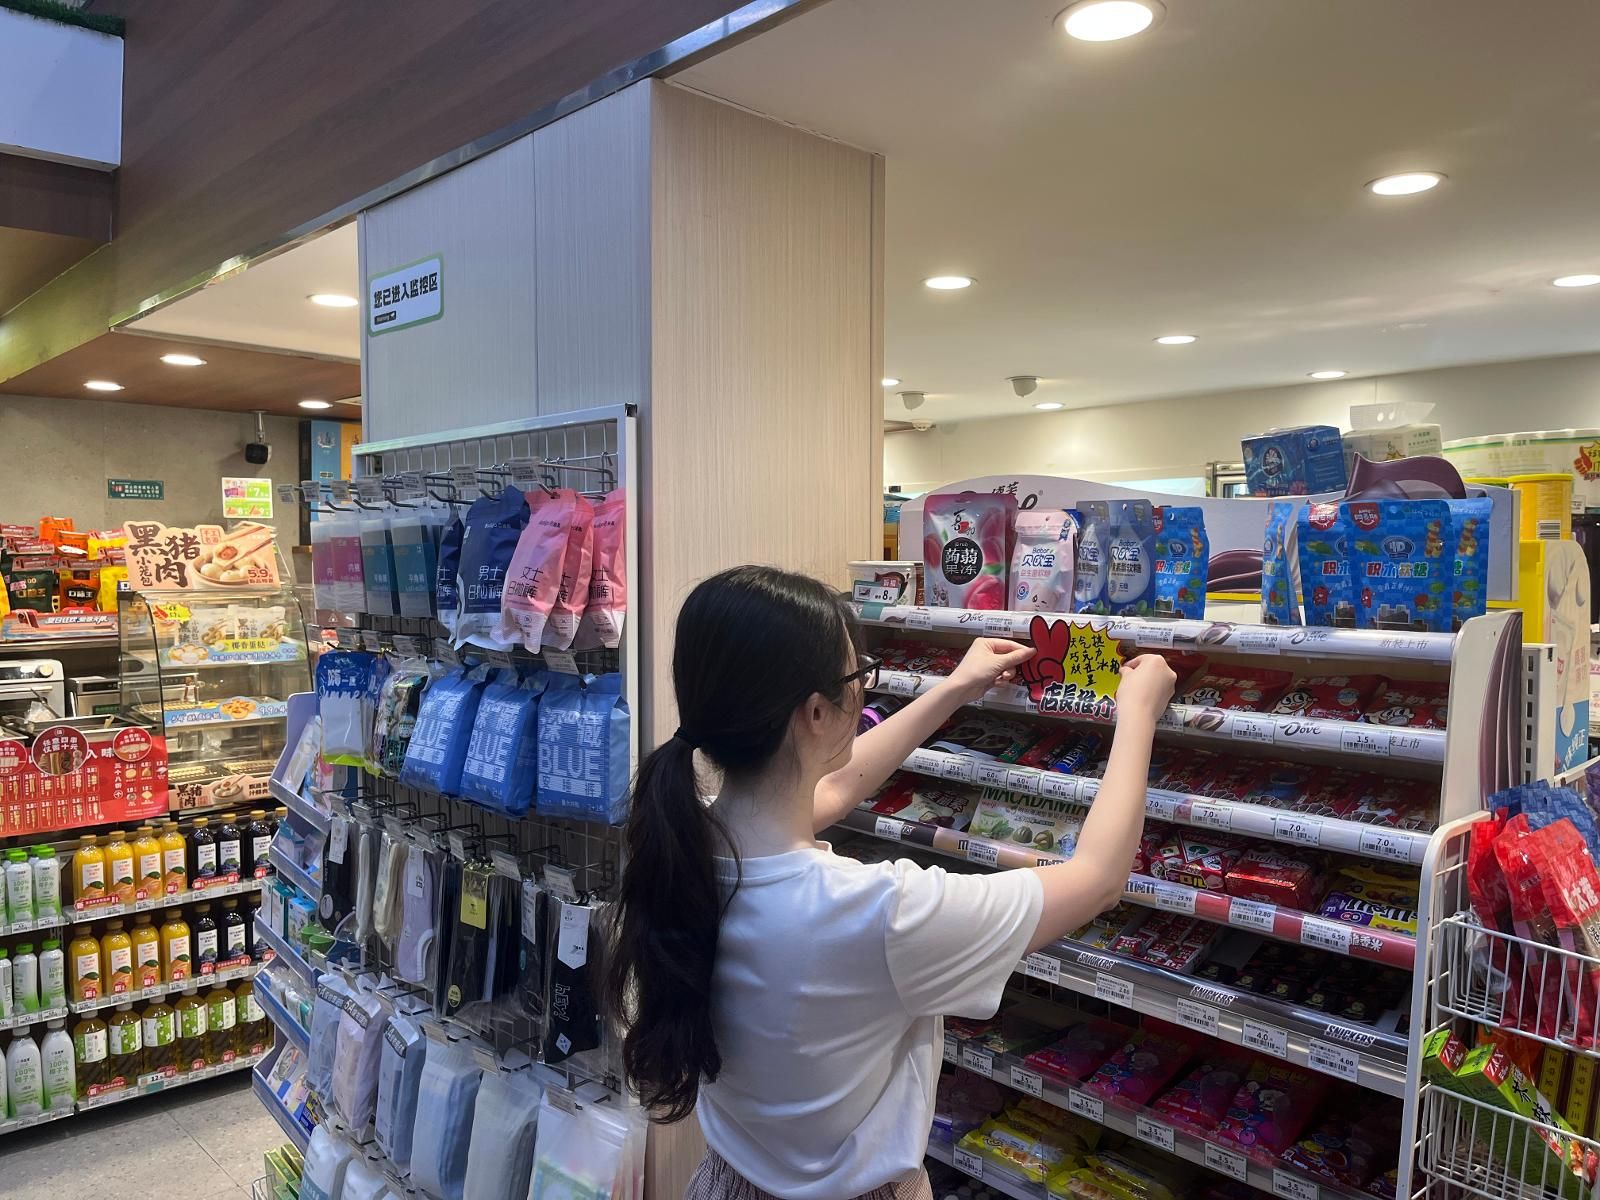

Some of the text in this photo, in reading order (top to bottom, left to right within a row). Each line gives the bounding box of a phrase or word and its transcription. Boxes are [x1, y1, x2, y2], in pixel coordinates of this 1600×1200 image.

[374, 272, 438, 309] 您已进入监控区
[945, 548, 978, 564] 蒟蒻
[1022, 554, 1055, 567] 贝欧宝
[136, 556, 153, 587] 小笼包
[155, 559, 188, 588] 肉
[479, 566, 503, 581] 男士
[520, 566, 543, 582] 女士
[945, 564, 977, 575] 果冻
[1366, 561, 1428, 578] 积木软糖
[957, 613, 983, 623] Dove
[1100, 620, 1131, 632] Dove
[1070, 633, 1105, 648] 天气热
[1286, 631, 1327, 645] Dove
[1379, 638, 1427, 650] 新装上市
[1070, 648, 1102, 663] 巧克力
[1280, 721, 1321, 736] Dove
[467, 729, 513, 767] BLUE
[539, 743, 601, 781] BLUE
[1203, 810, 1214, 818] 7.0
[1377, 838, 1389, 846] 7.0
[1254, 910, 1271, 918] 12.80
[1331, 932, 1346, 941] 6.50
[1078, 952, 1118, 970] SNICKERS
[1191, 985, 1236, 1006] SNICKERS
[1257, 1032, 1269, 1040] 4.0
[1325, 1025, 1376, 1047] SNICKERS
[1339, 1058, 1354, 1066] 4.00
